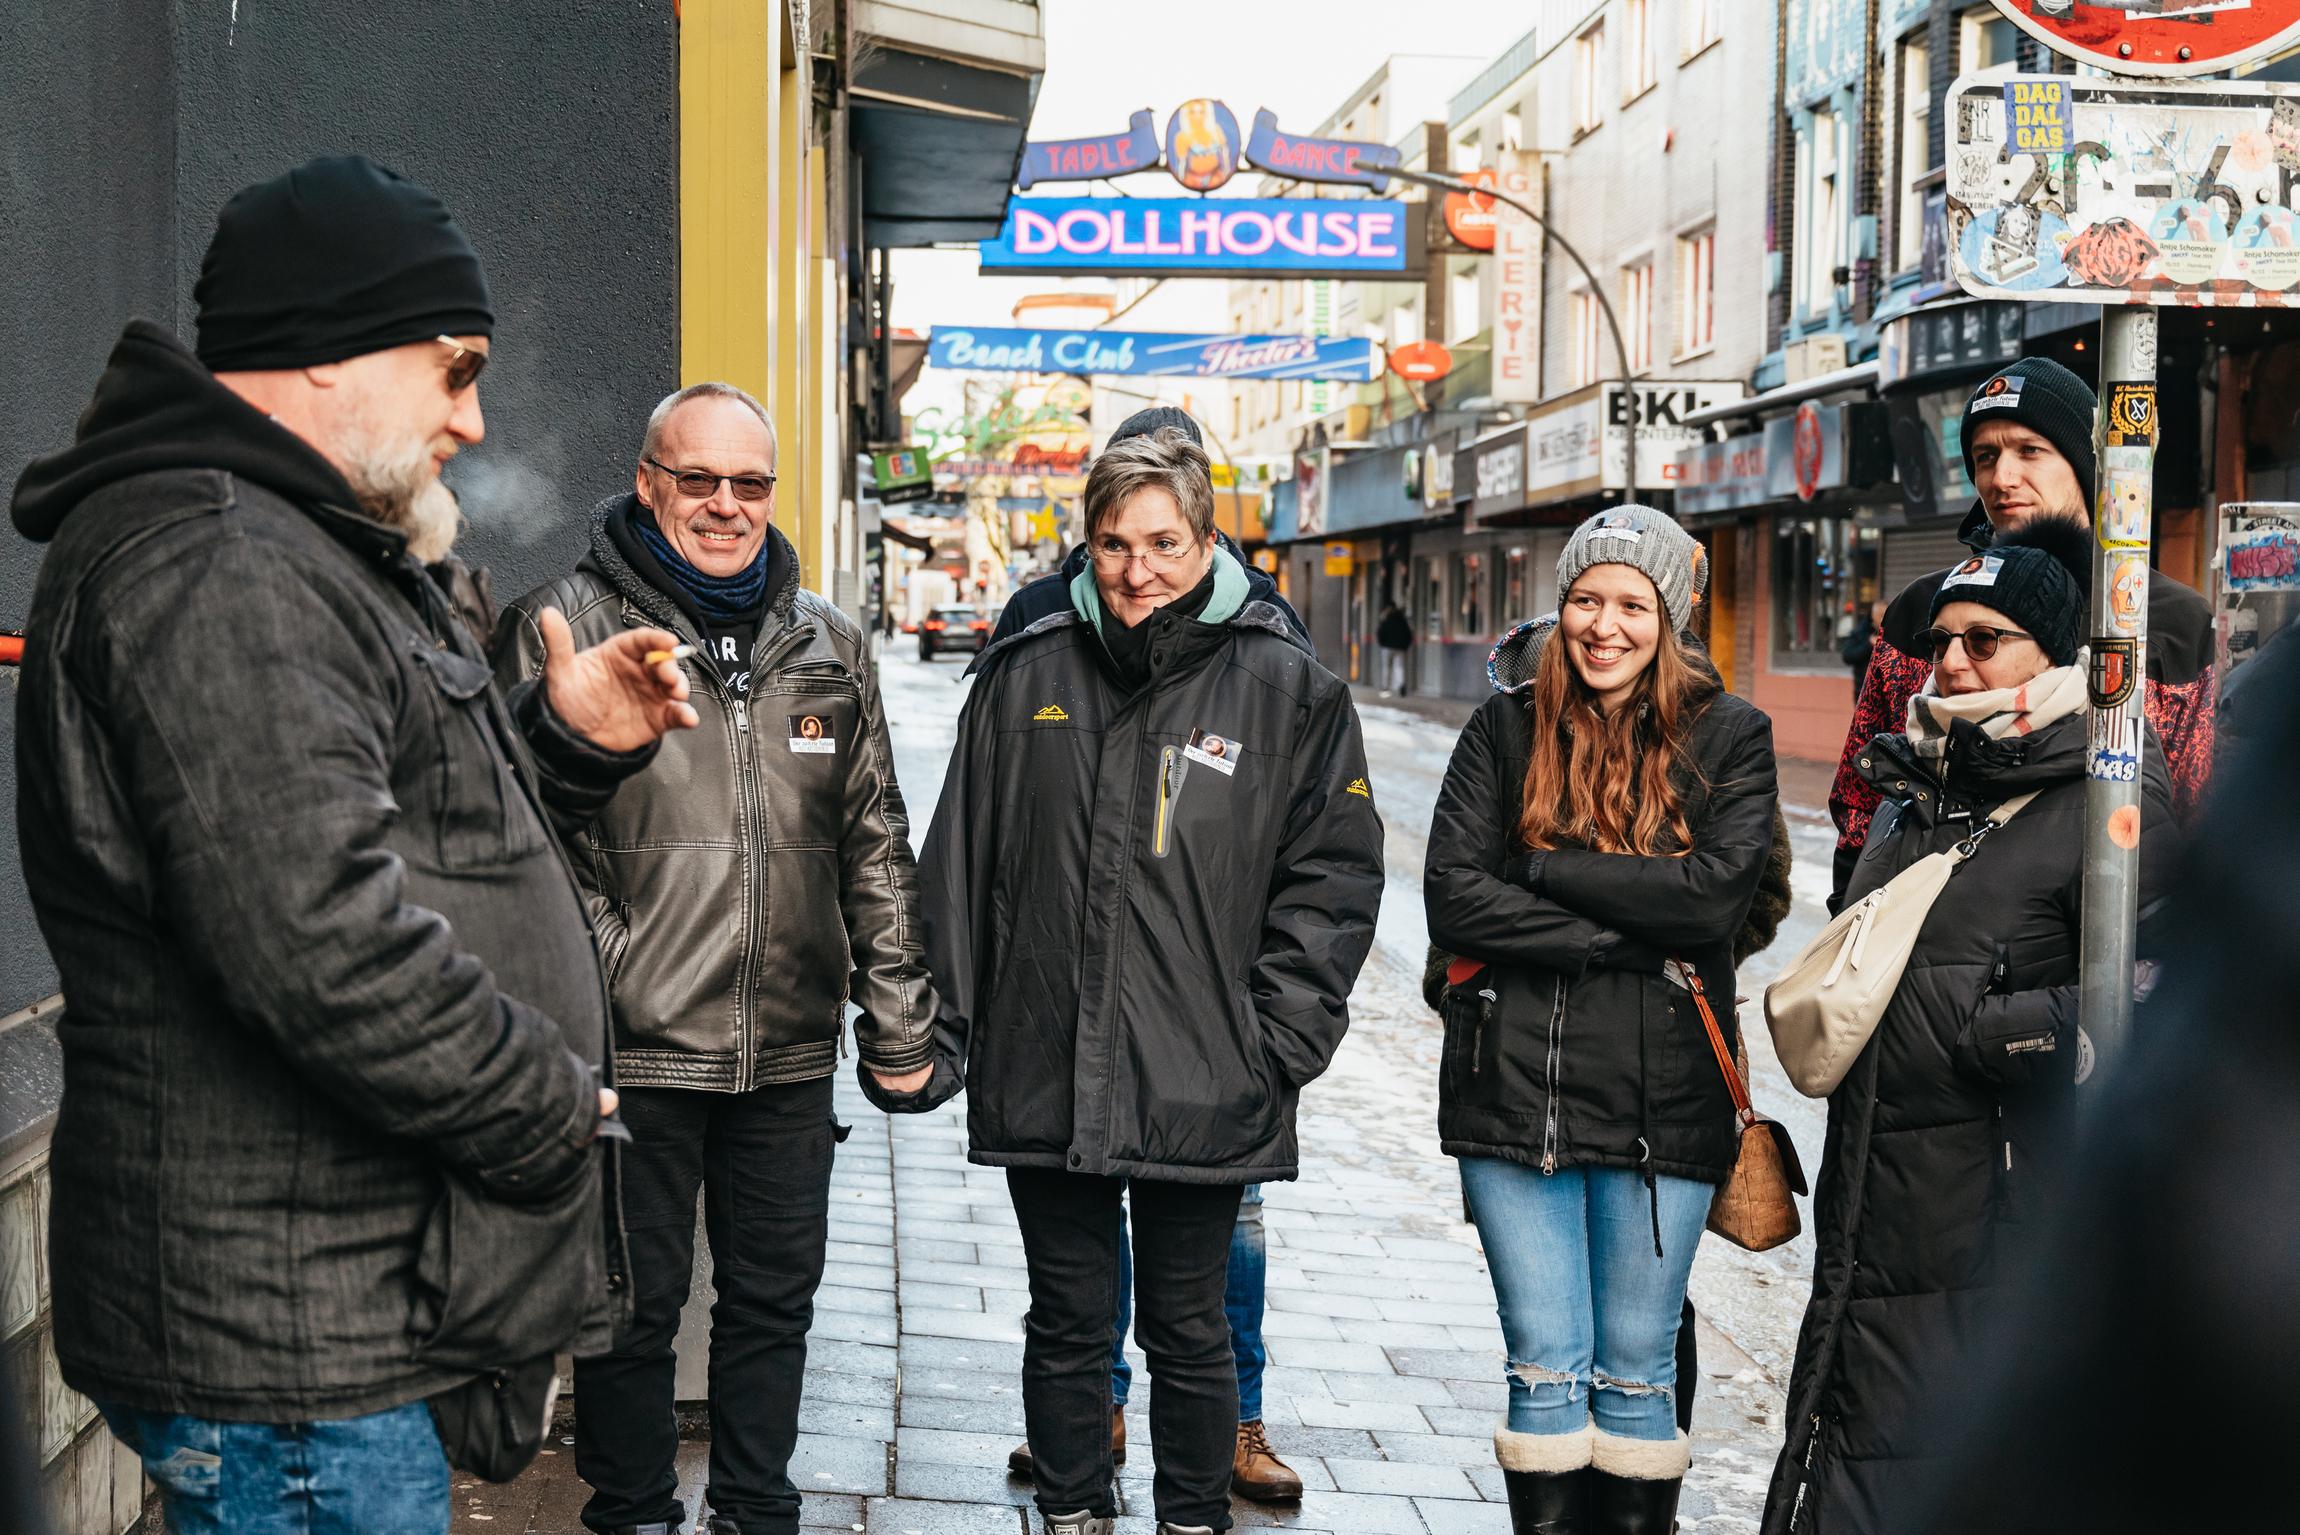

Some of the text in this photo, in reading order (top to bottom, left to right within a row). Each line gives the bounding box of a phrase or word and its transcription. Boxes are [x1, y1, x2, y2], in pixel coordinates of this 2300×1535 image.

[2014, 83, 2062, 105] DAG
[2015, 105, 2064, 127] DAL
[2016, 127, 2065, 149] GAS
[1045, 136, 1362, 178] TABLE DANCE
[1013, 209, 1397, 256] DOLLHOUSE
[939, 332, 1042, 369] Beach
[1053, 334, 1135, 371] Club
